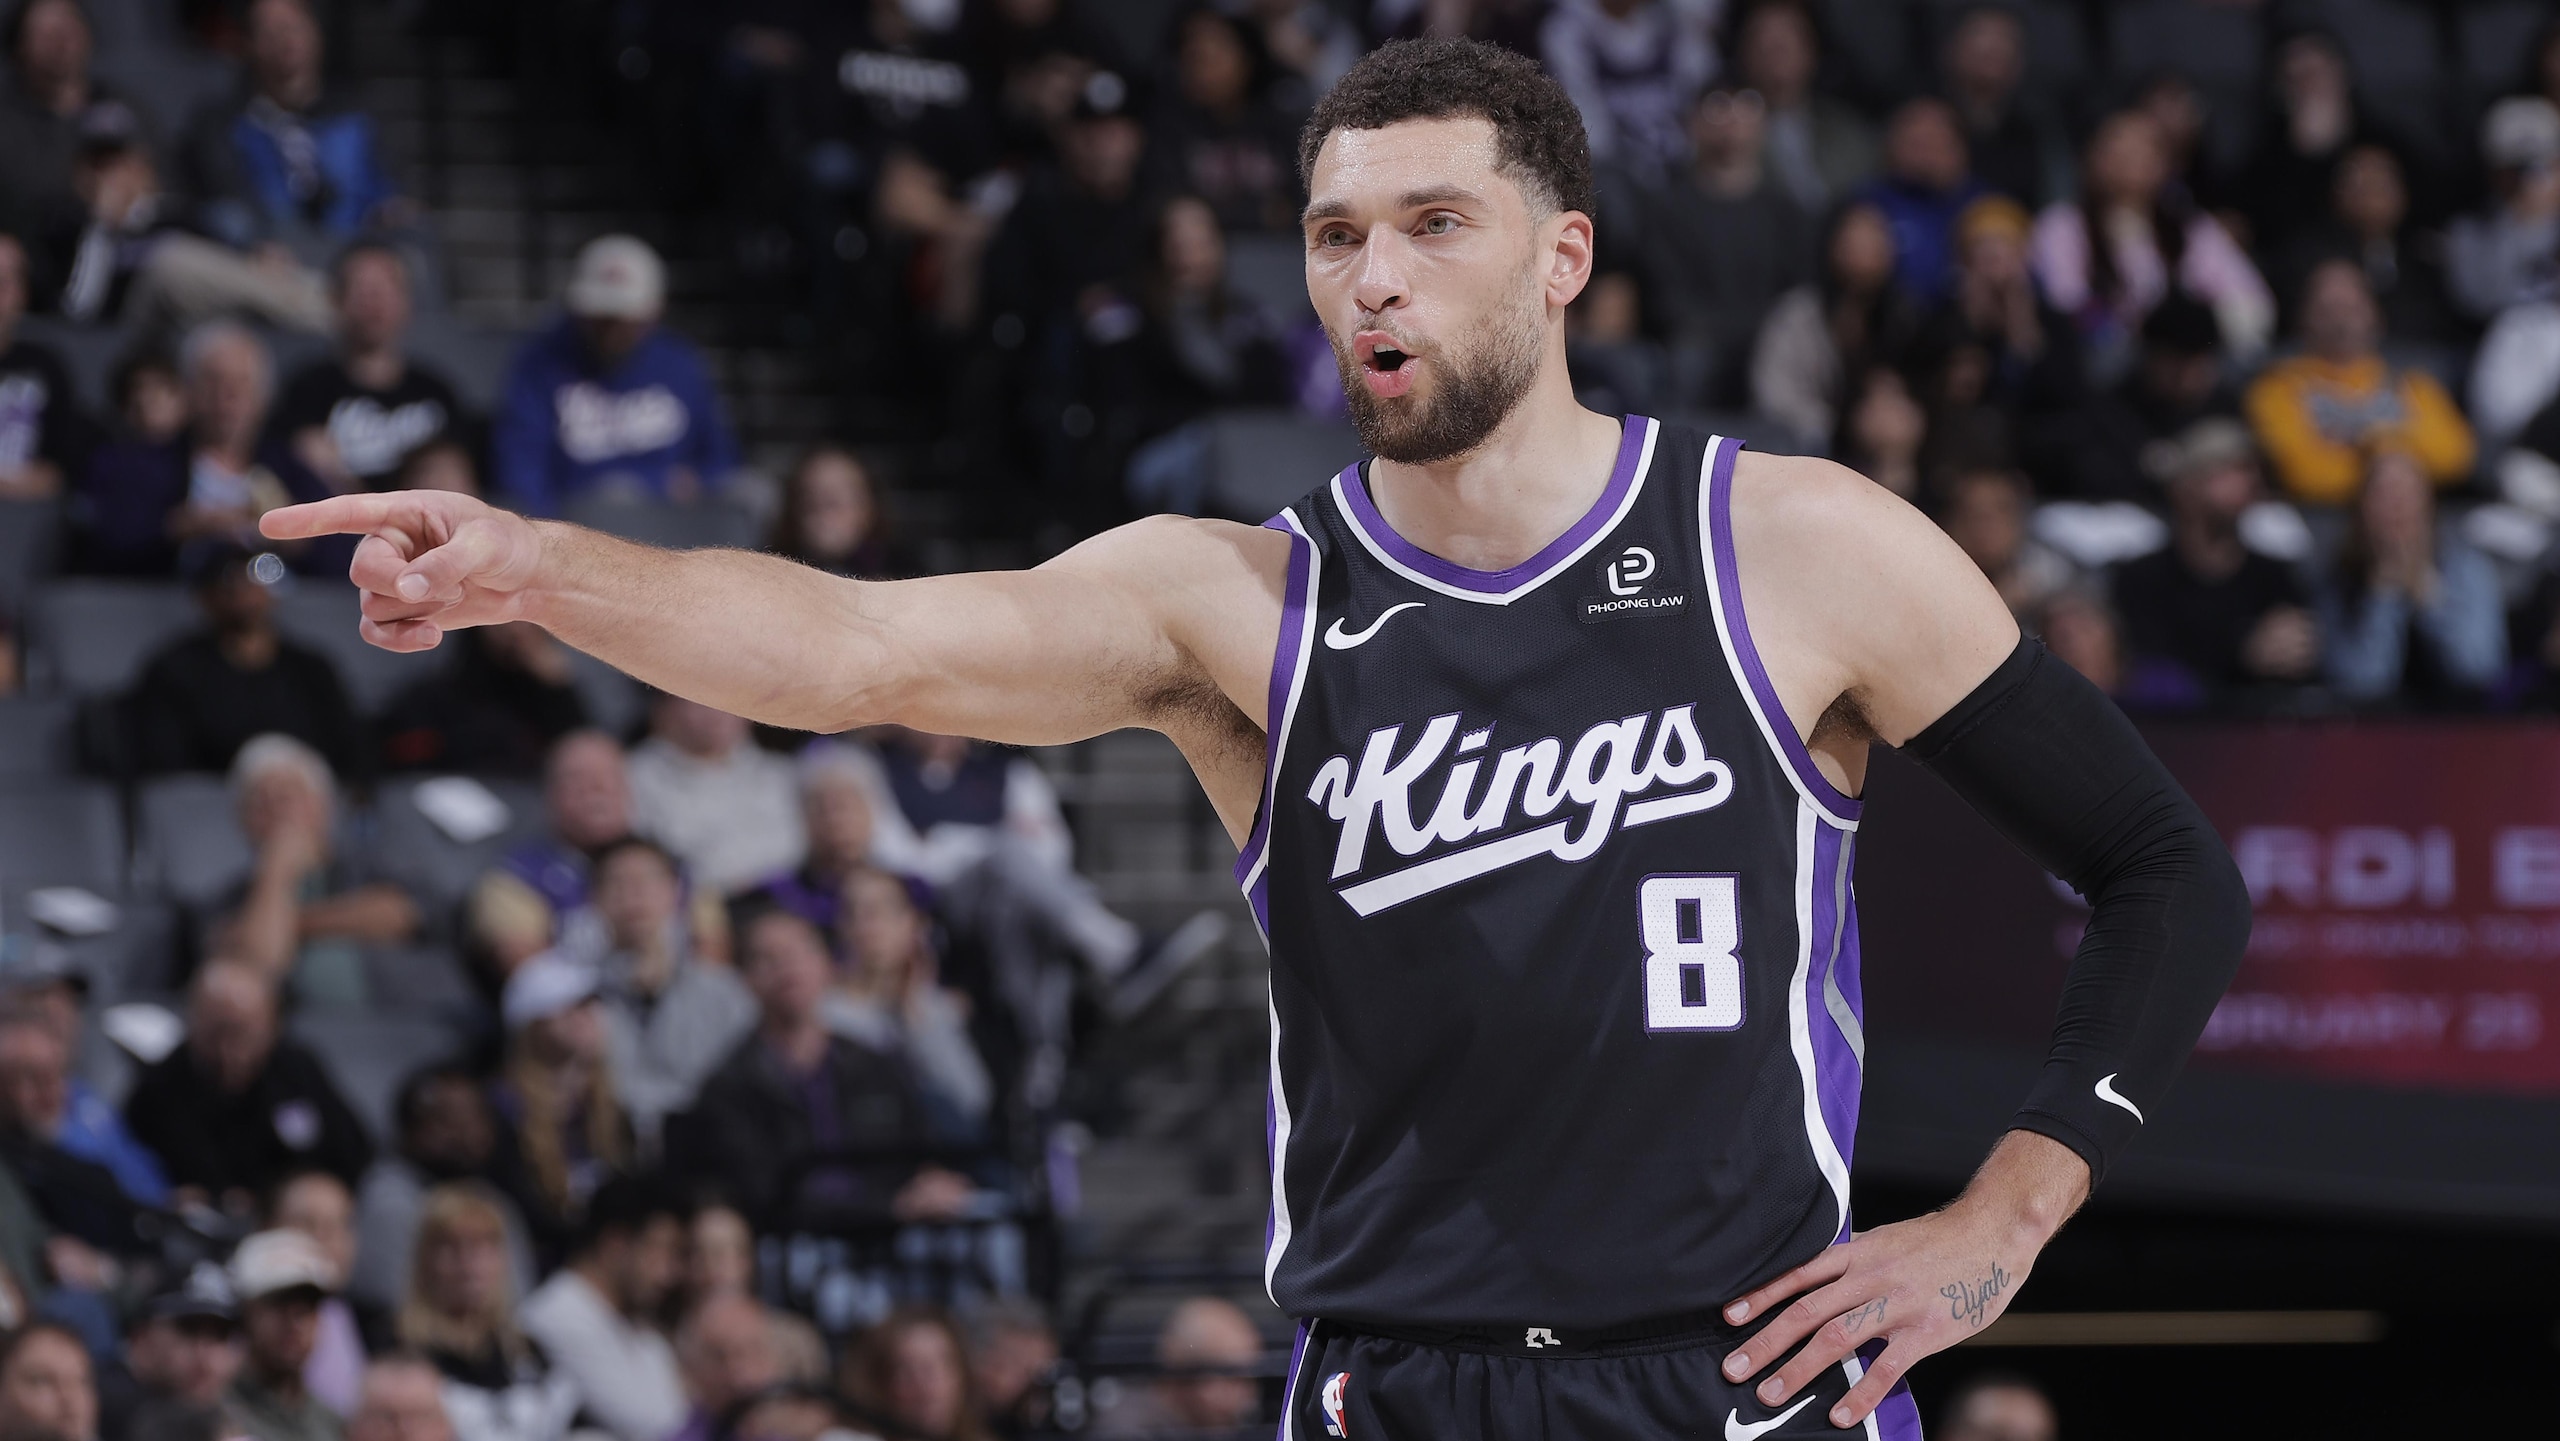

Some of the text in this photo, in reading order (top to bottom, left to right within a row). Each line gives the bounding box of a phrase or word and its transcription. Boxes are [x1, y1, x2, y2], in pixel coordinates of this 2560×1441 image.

[1587, 595, 1684, 615] PHOONG LAW
[1304, 702, 1736, 919] Kings
[1636, 871, 1747, 1034] 8
[1940, 1261, 2010, 1327] Elijah
